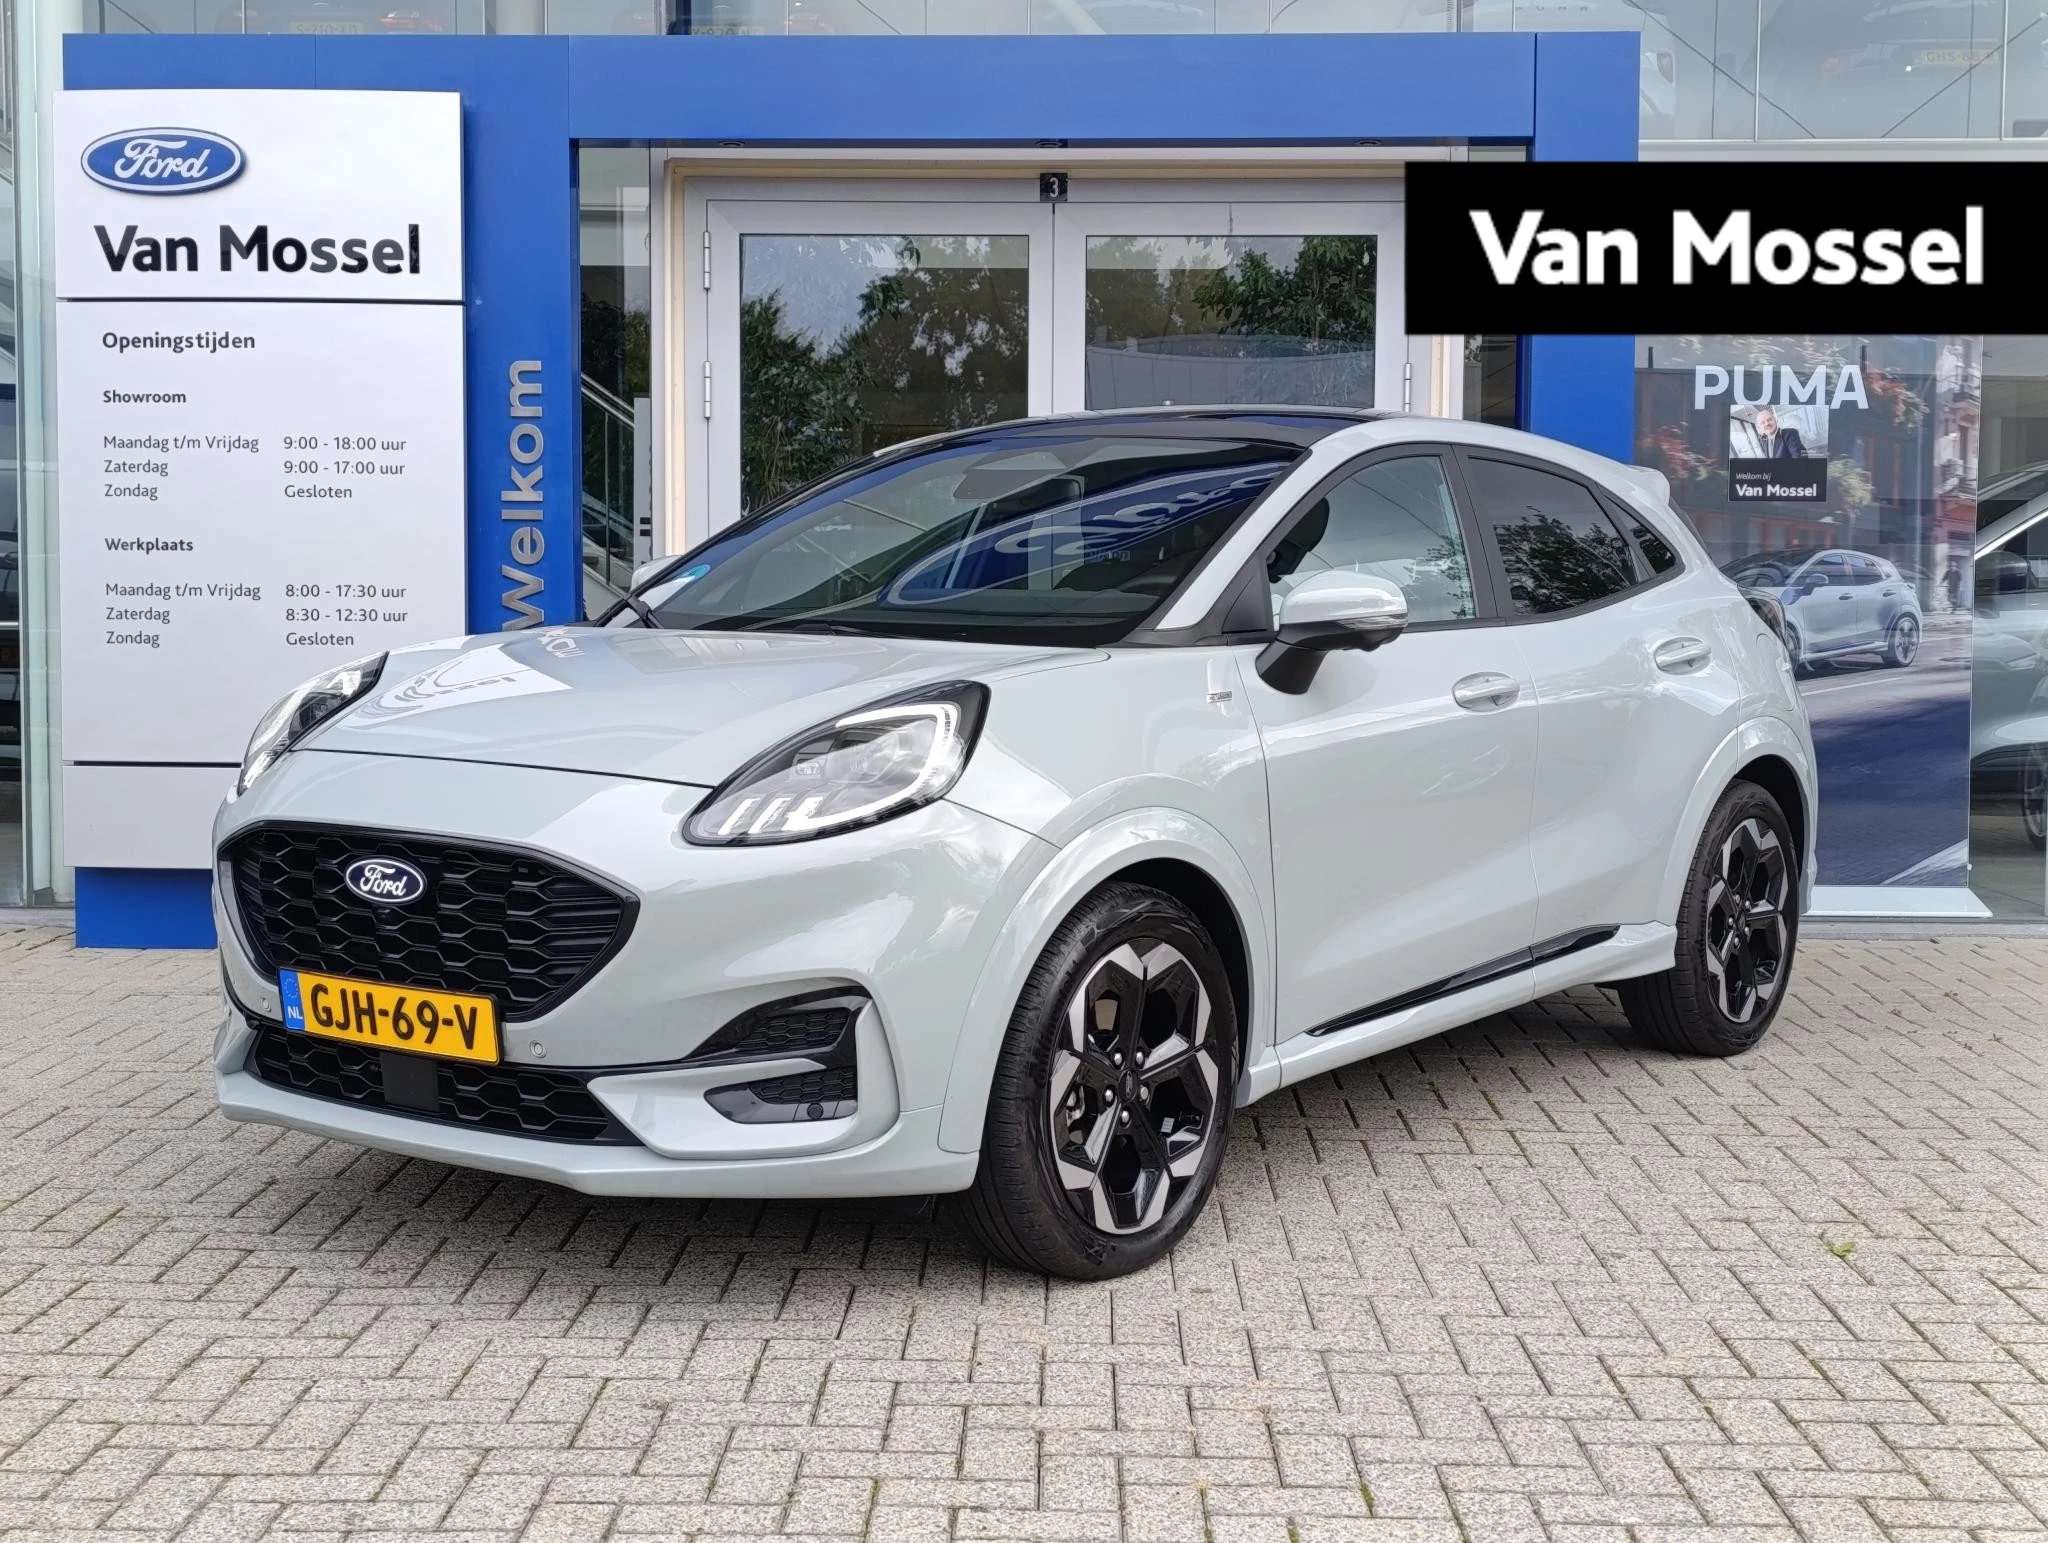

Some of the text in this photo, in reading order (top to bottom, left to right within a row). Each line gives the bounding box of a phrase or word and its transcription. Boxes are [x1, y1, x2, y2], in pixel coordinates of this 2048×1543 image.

[114, 138, 211, 179] Ford
[1049, 176, 1059, 198] 3
[94, 223, 421, 274] Van Mossel
[102, 331, 256, 354] Openingstijden
[103, 389, 187, 403] Showroom
[1694, 364, 1869, 410] PUMA
[103, 434, 260, 454] Maandag t/m Vrijdag
[283, 436, 319, 450] 9:00
[333, 436, 377, 450] 18:00
[381, 440, 407, 451] uur
[103, 459, 169, 477] Zaterdag
[283, 460, 319, 474] 9:00
[333, 461, 376, 474] 17:00
[380, 465, 406, 475] uur
[1736, 472, 1772, 482] Welkom bij
[104, 483, 159, 501] Zondag
[284, 484, 353, 498] Gesloten
[501, 360, 545, 632] Welkom
[1735, 483, 1818, 497] Van Mossel
[104, 536, 194, 556] Werkplaats
[105, 582, 262, 601] Maandag t/m Vrijdag
[285, 584, 321, 597] 8:00
[335, 584, 377, 598] 17:30
[381, 588, 407, 598] uur
[105, 606, 171, 625] Zaterdag
[285, 608, 321, 622] 8:30
[335, 608, 379, 622] 12:30
[382, 612, 409, 622] uur
[106, 630, 161, 648] Zondag
[285, 631, 354, 646] Gesloten
[360, 864, 408, 896] Ford
[287, 1005, 303, 1020] NL
[310, 983, 478, 1050] GJH-69-V
